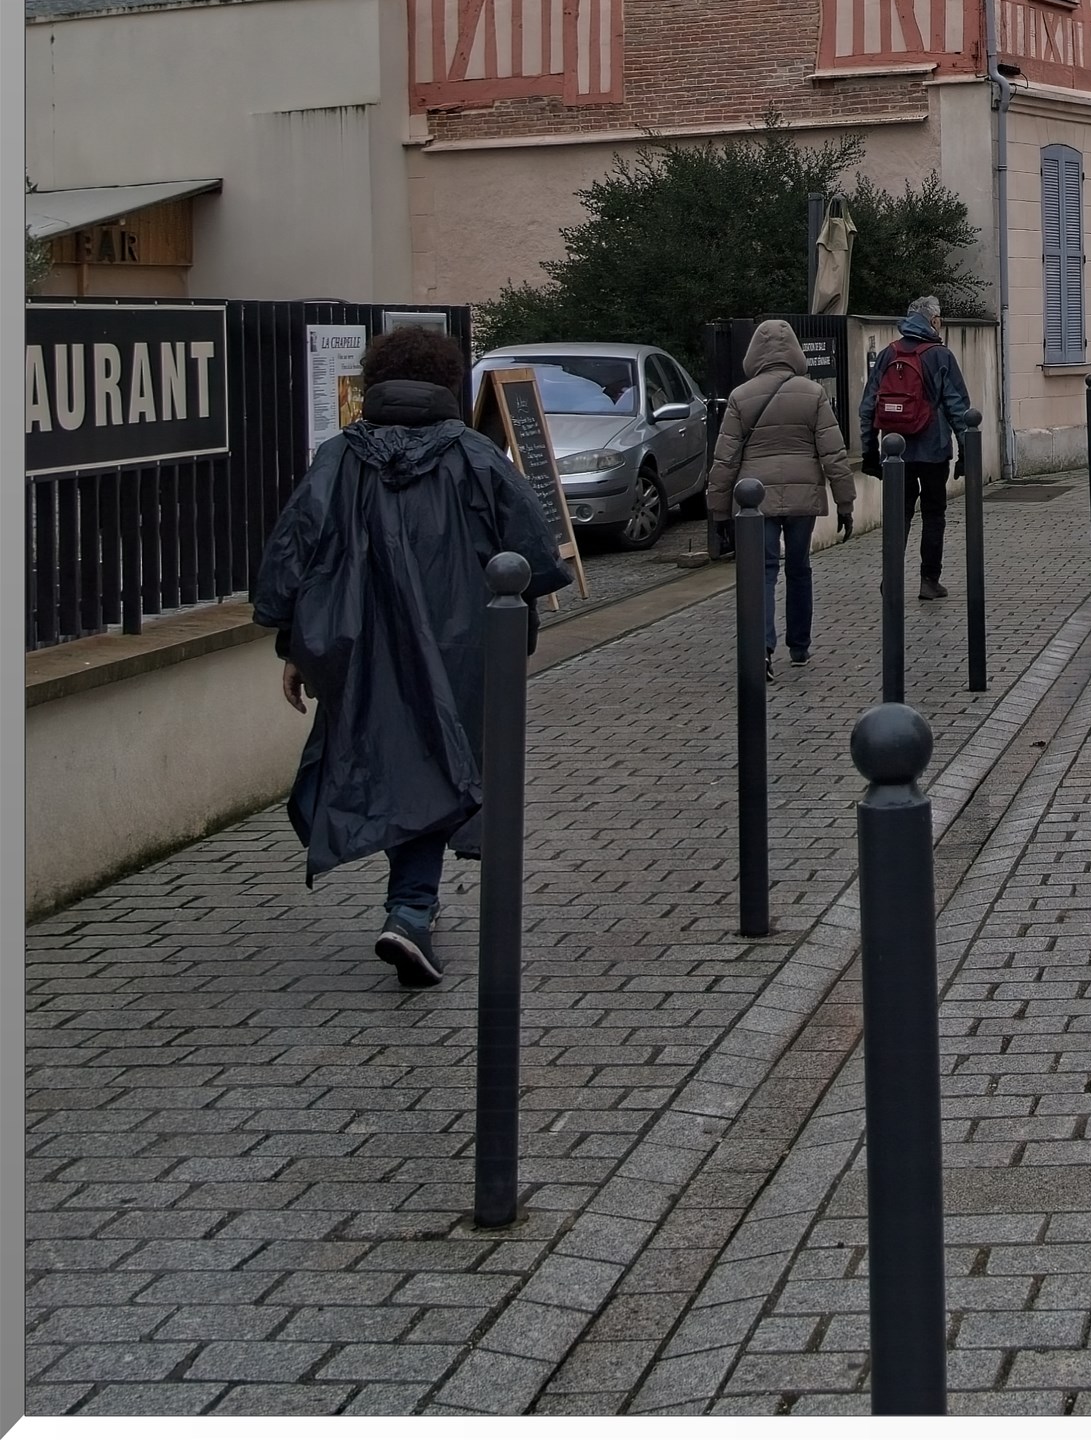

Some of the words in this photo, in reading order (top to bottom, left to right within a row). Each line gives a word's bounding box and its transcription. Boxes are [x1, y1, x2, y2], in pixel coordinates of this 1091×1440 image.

[76, 227, 139, 263] BAR
[321, 336, 330, 349] LA
[330, 336, 361, 349] CHAPELLE
[26, 341, 215, 434] AURANT
